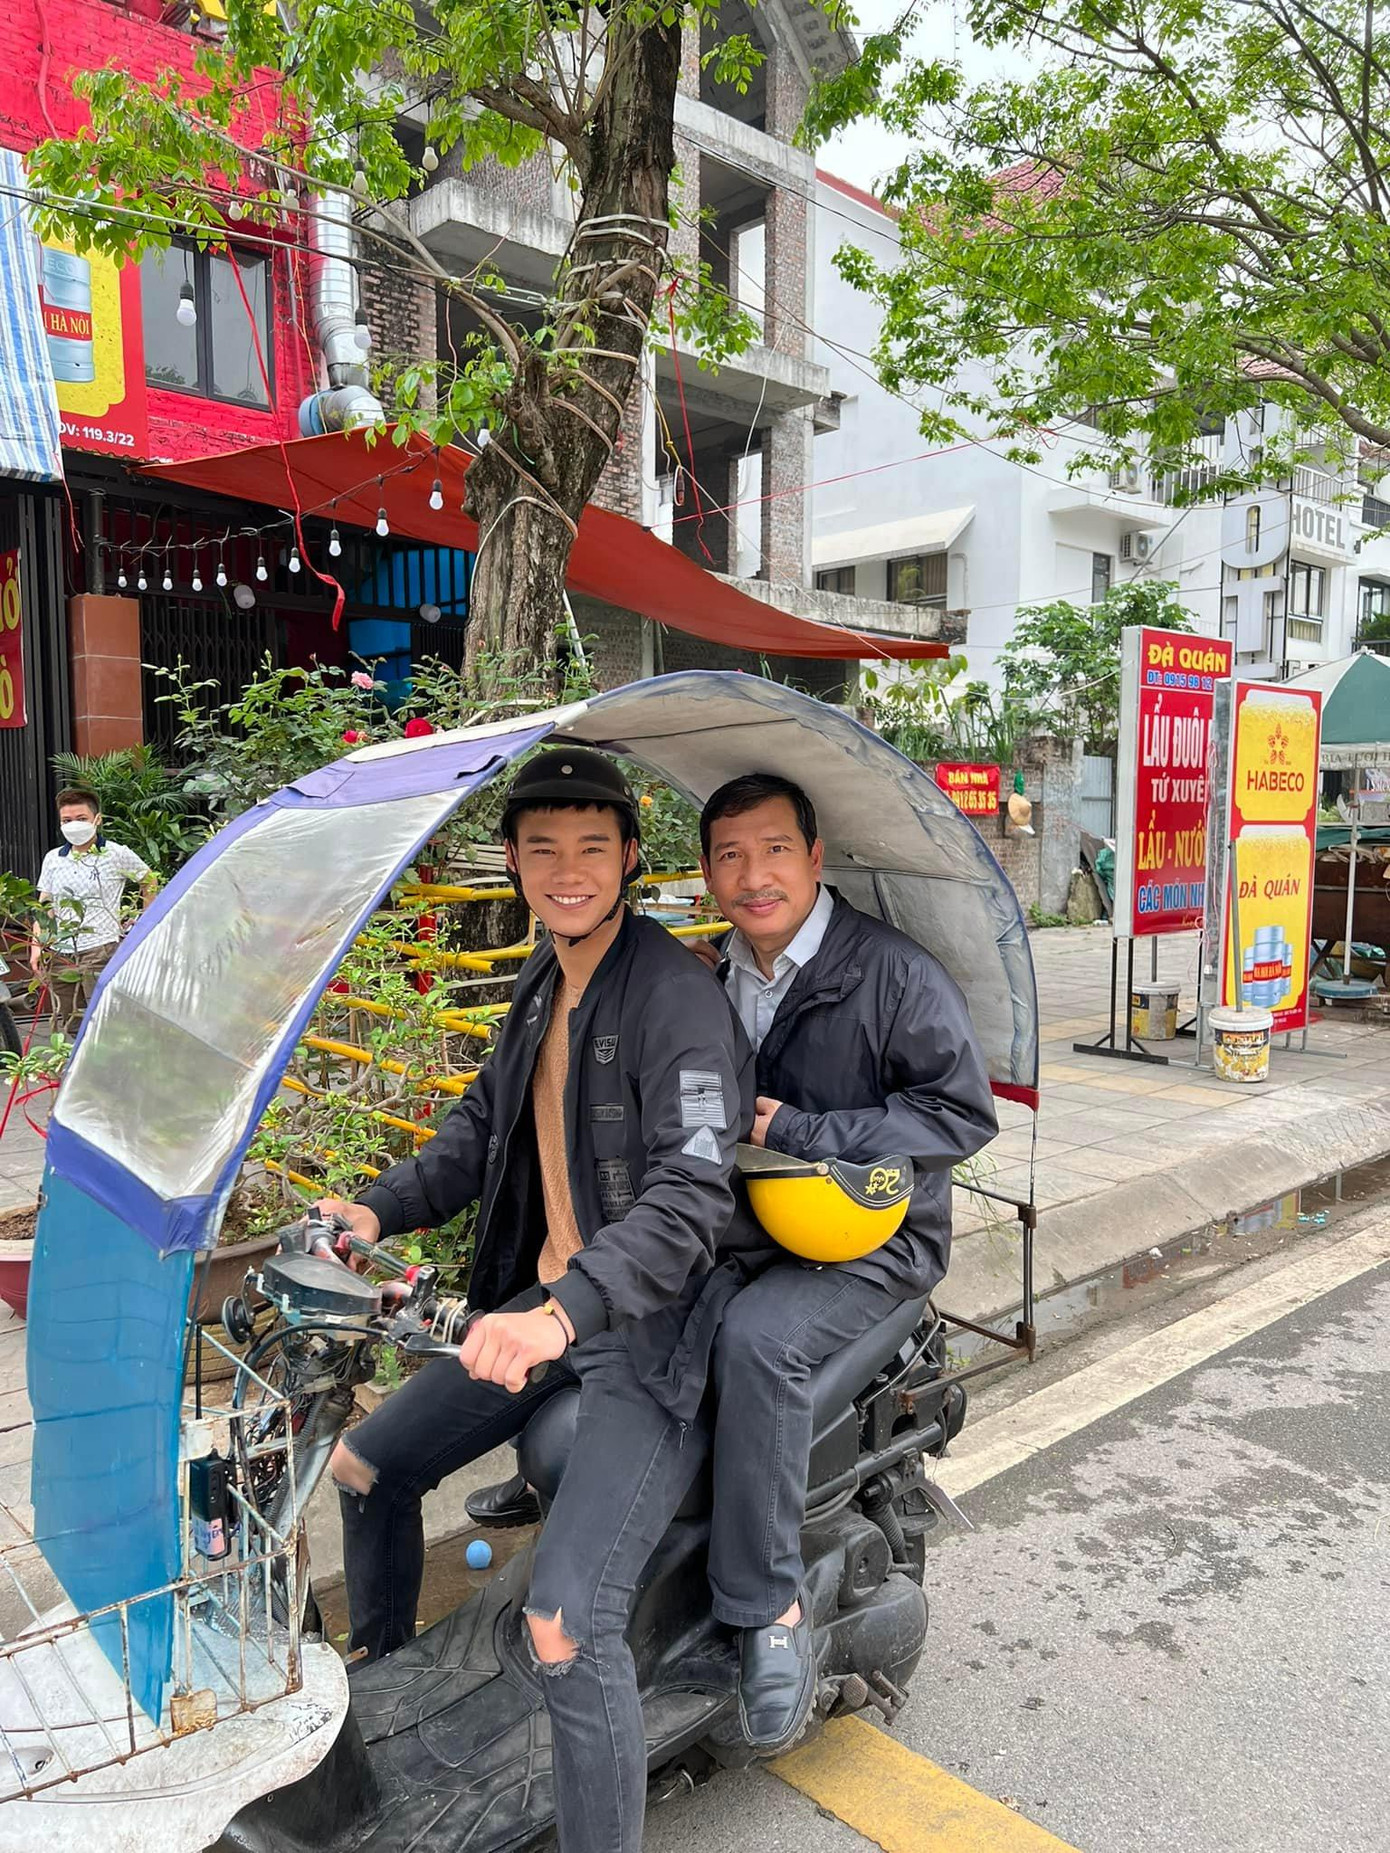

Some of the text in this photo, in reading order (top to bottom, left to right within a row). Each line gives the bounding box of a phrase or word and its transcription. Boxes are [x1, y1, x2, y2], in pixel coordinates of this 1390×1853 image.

[51, 310, 68, 333] HÀ
[70, 315, 90, 340] NỘI
[82, 426, 135, 447] 119.3/22
[1291, 503, 1345, 550] HOTEL
[1147, 641, 1227, 673] ĐÀ QUÁN
[1164, 673, 1186, 688] 0915
[1143, 693, 1170, 767] LẨU
[1172, 707, 1204, 768] ĐUÔI
[1151, 772, 1170, 802] TỨ
[1247, 770, 1305, 792] HABECO
[1138, 809, 1166, 870] LẨU
[1174, 819, 1206, 868] NƯỚ
[1138, 880, 1160, 913] CÁC
[1163, 878, 1186, 911] MÓN
[1239, 873, 1300, 900] ĐÀ QUÁN
